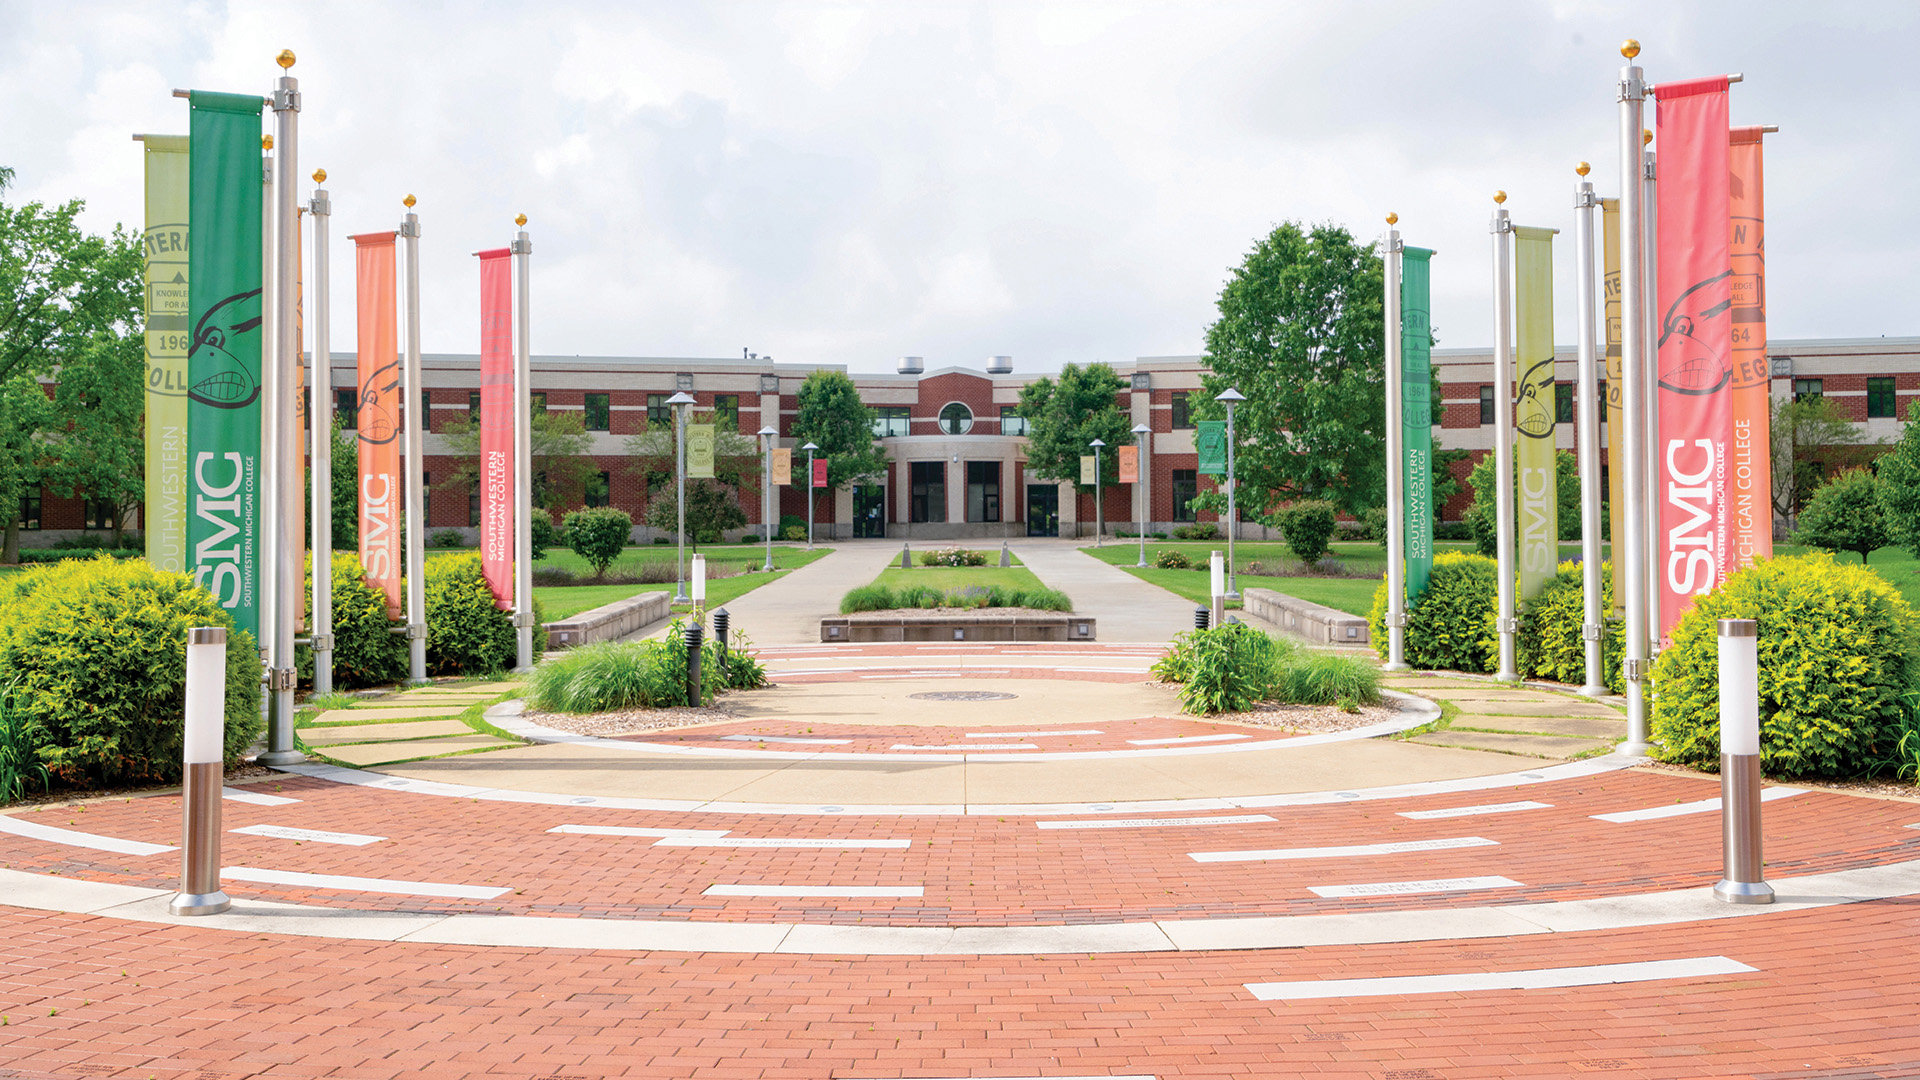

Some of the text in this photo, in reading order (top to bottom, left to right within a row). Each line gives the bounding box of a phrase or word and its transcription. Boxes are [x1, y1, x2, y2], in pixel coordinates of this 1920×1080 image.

[156, 290, 189, 298] KNOWLE
[1408, 386, 1425, 398] 1964
[488, 451, 497, 561] SOUTHWESTERN
[497, 451, 505, 501] COLLEGE
[1410, 448, 1420, 559] SOUTHWESTERN
[1716, 442, 1725, 479] COLLEGE
[1716, 480, 1725, 524] MICHIGAN
[1736, 419, 1752, 490] COLLEGE
[194, 452, 243, 608] SMC
[244, 456, 254, 608] SOUTHWESTERN MICHIGAN COLLEGE
[363, 473, 390, 580] SMC
[1522, 467, 1548, 573] SMC
[1666, 438, 1714, 596] SMC
